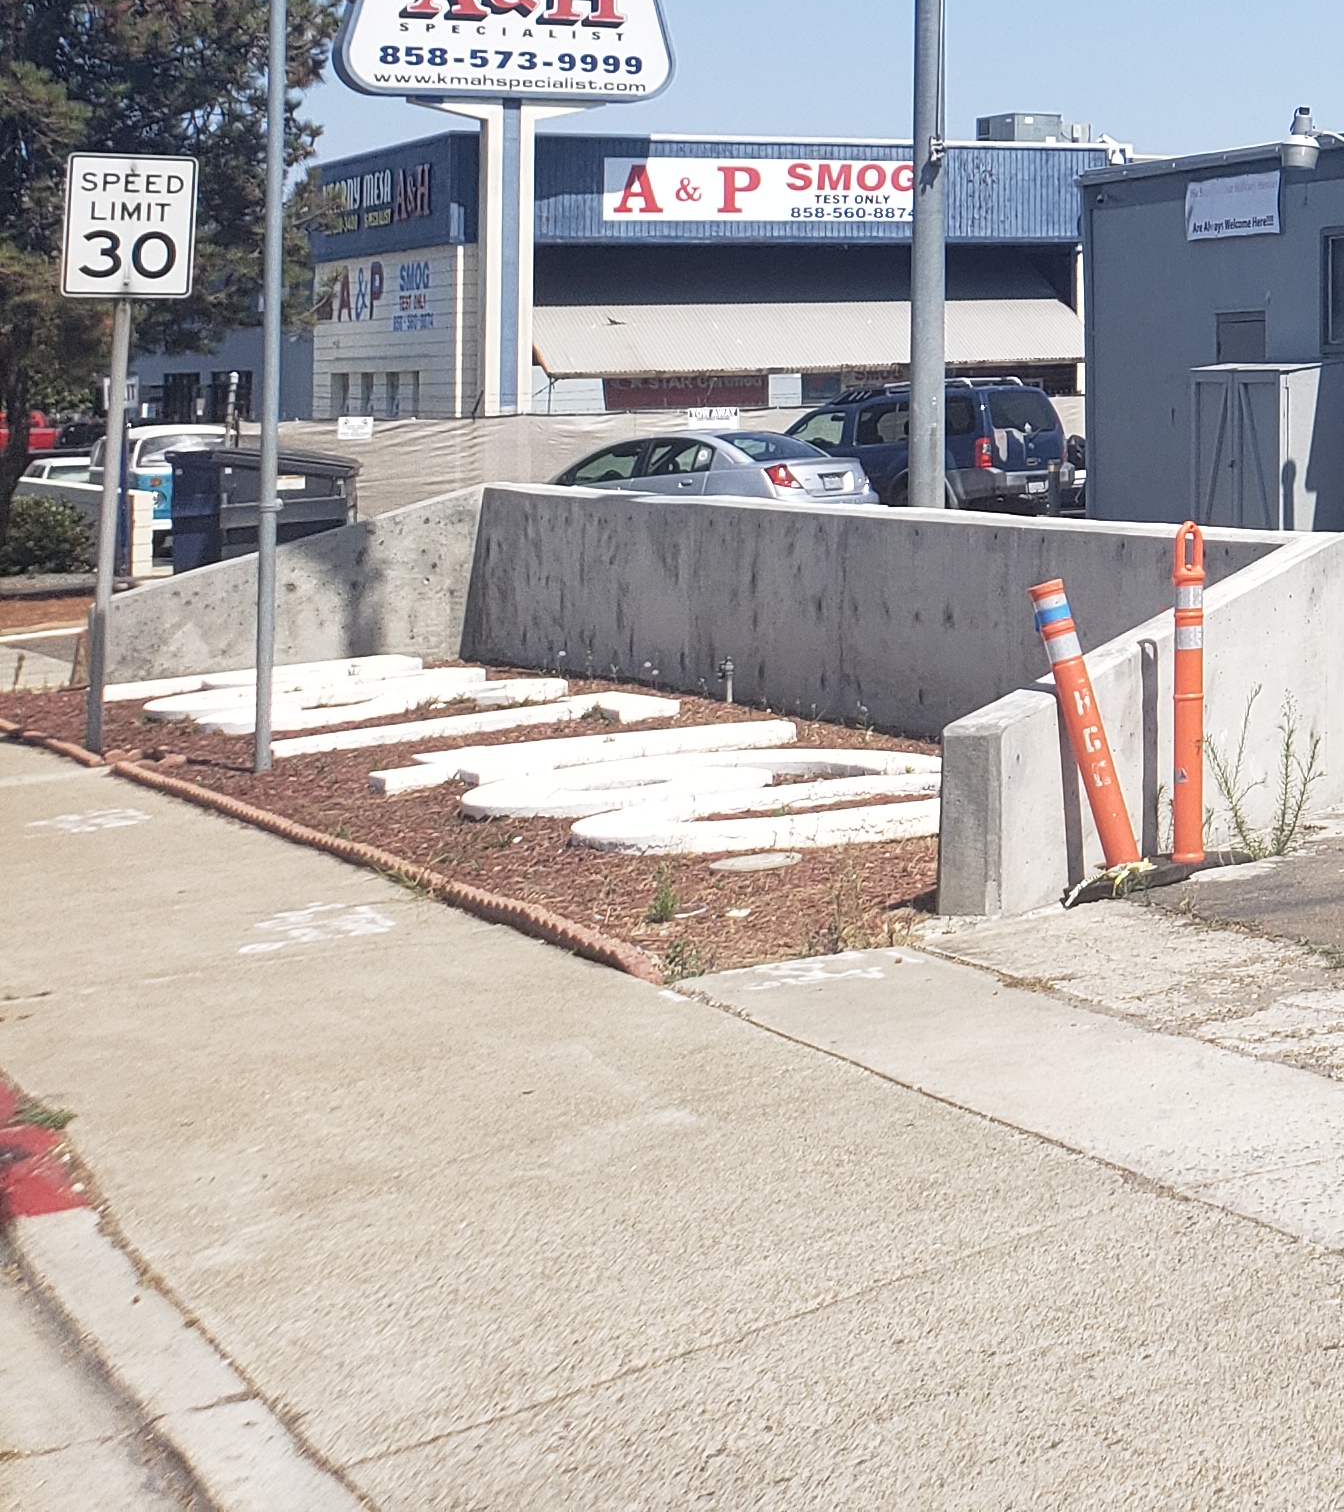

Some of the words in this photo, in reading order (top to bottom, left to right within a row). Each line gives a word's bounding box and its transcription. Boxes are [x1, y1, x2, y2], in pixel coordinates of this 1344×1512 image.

[399, 22, 625, 41] SPECIALIST
[379, 45, 643, 75] 858-573-9999
[373, 71, 646, 93] www.kmahspecialist.com
[81, 172, 184, 194] SPEED
[363, 169, 391, 207] MESA
[613, 164, 664, 213] A
[675, 177, 702, 202] &
[717, 165, 761, 213] P
[786, 163, 914, 192] SMOG
[91, 201, 171, 222] LIMIT
[815, 194, 849, 204] TEST
[854, 194, 891, 204] ONLY
[1193, 222, 1203, 234] Are
[1204, 220, 1224, 234] Alays
[1224, 218, 1252, 231] Welcome
[79, 229, 177, 279] 30
[400, 261, 430, 292] SMOG
